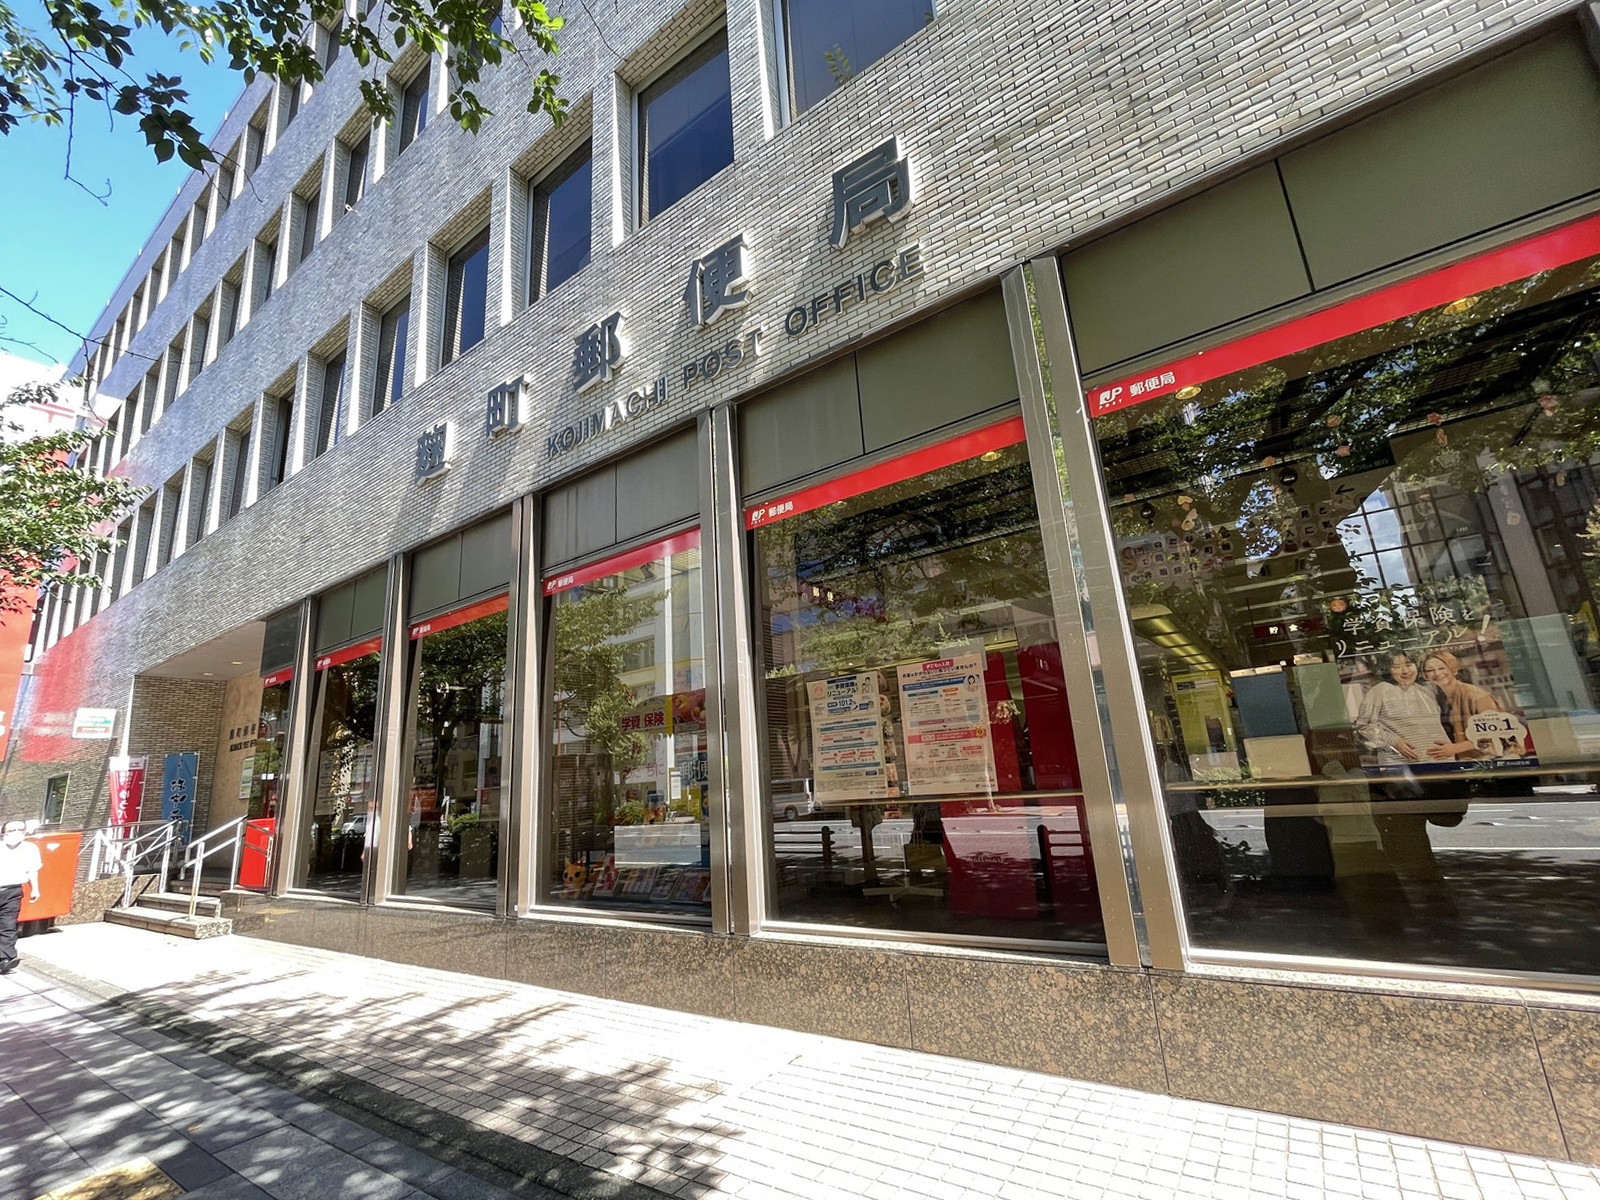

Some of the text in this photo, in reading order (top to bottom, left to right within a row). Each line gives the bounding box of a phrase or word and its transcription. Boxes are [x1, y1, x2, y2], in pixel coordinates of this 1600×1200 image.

[547, 241, 927, 459] KOJIMACHI POST OFFICE
[1129, 371, 1176, 397] 郵便局
[1473, 717, 1516, 733] No.1
